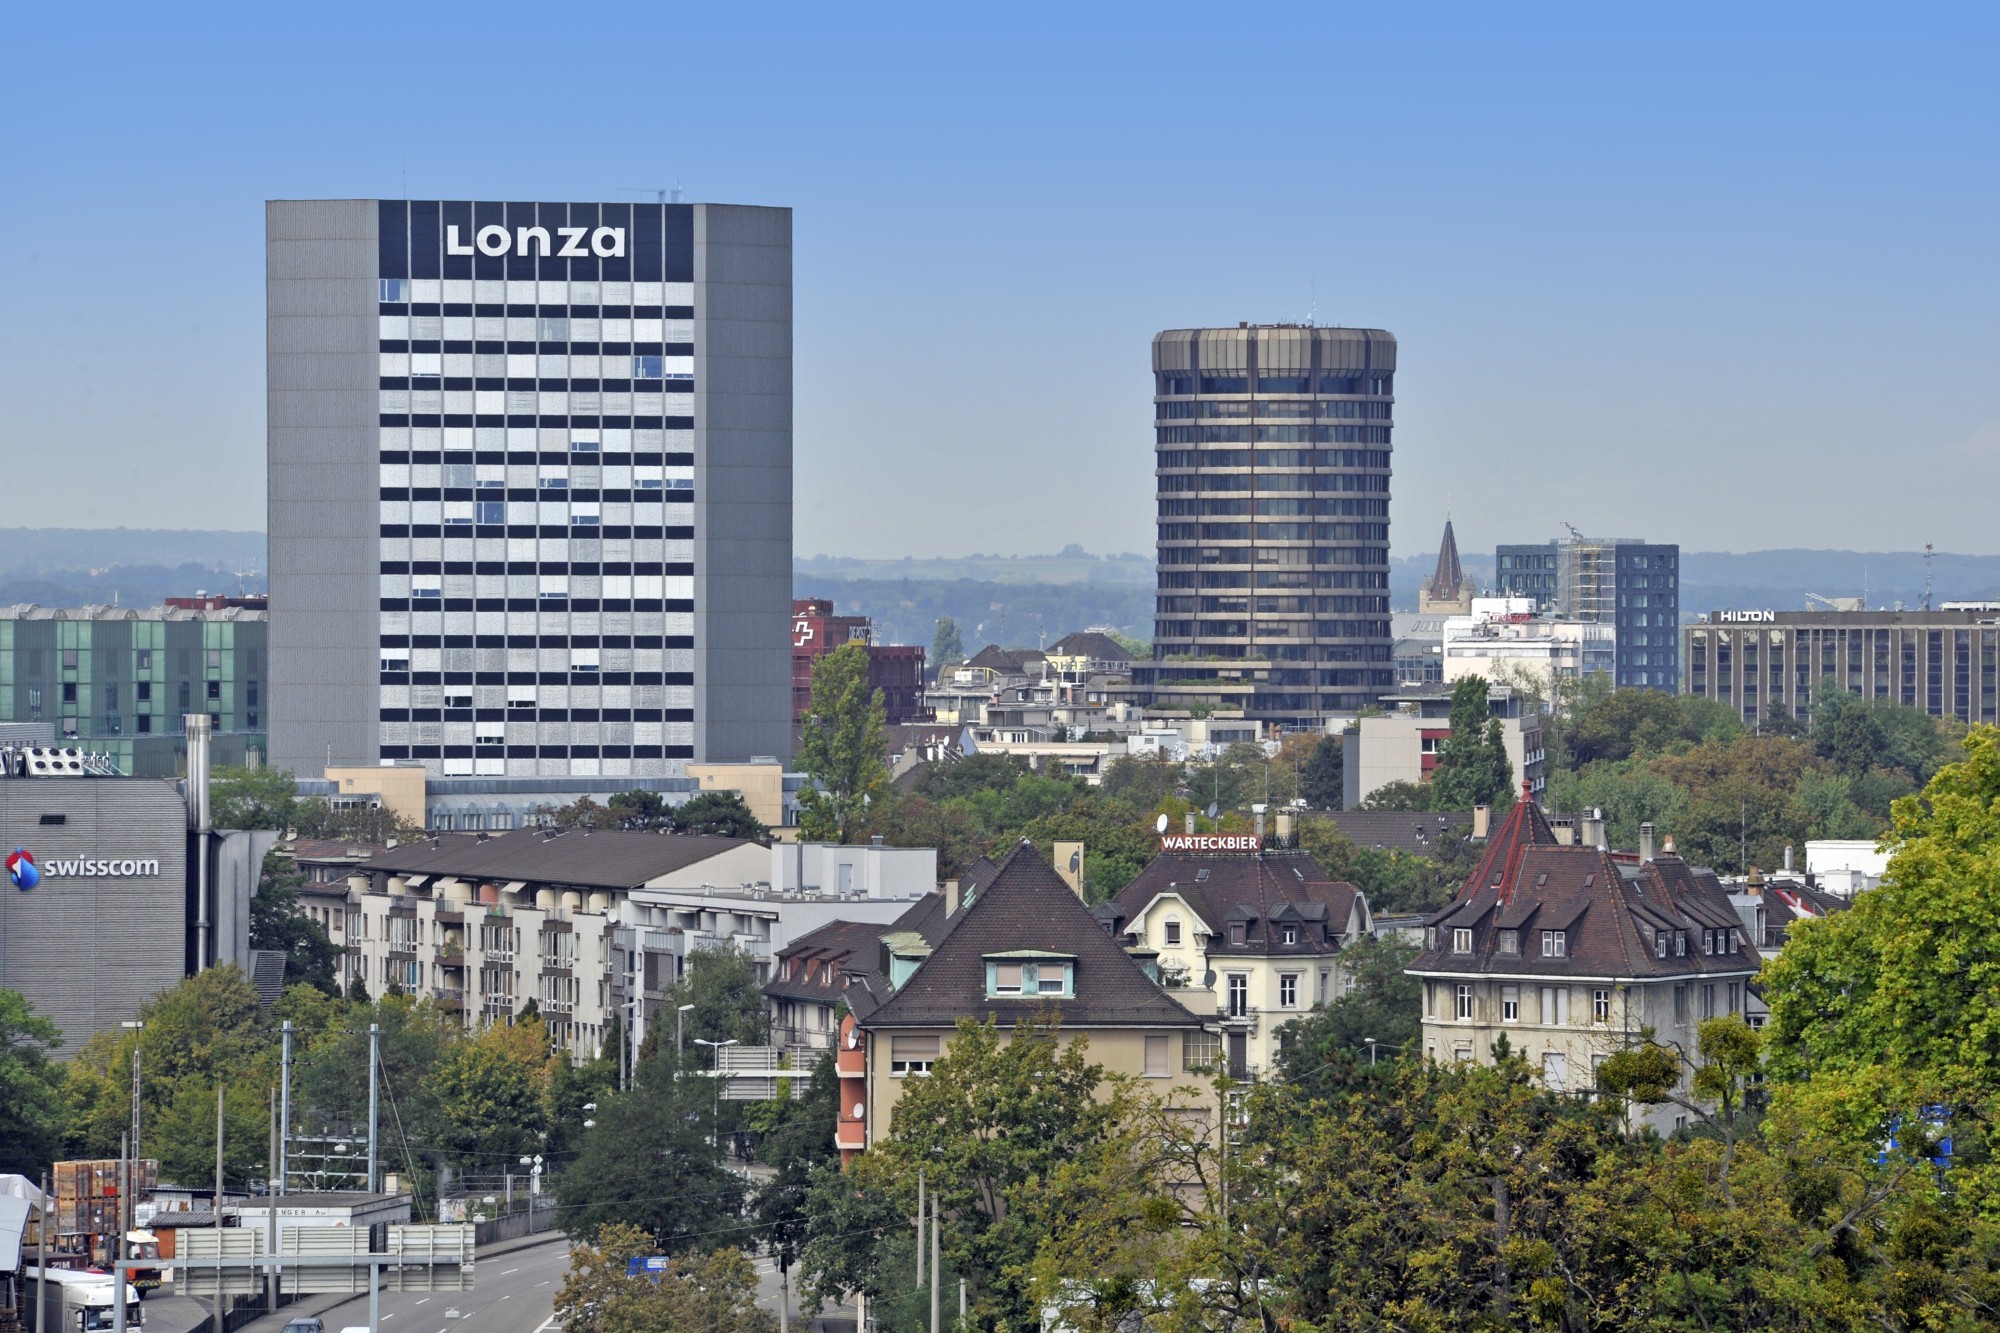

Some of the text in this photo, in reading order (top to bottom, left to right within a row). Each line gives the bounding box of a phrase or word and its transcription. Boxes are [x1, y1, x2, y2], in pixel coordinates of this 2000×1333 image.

[447, 225, 626, 258] Lonza
[1720, 610, 1775, 622] HILTON
[1162, 836, 1258, 850] WARTECKBIER
[44, 853, 159, 877] swisscom
[51, 1261, 70, 1269] ZIM
